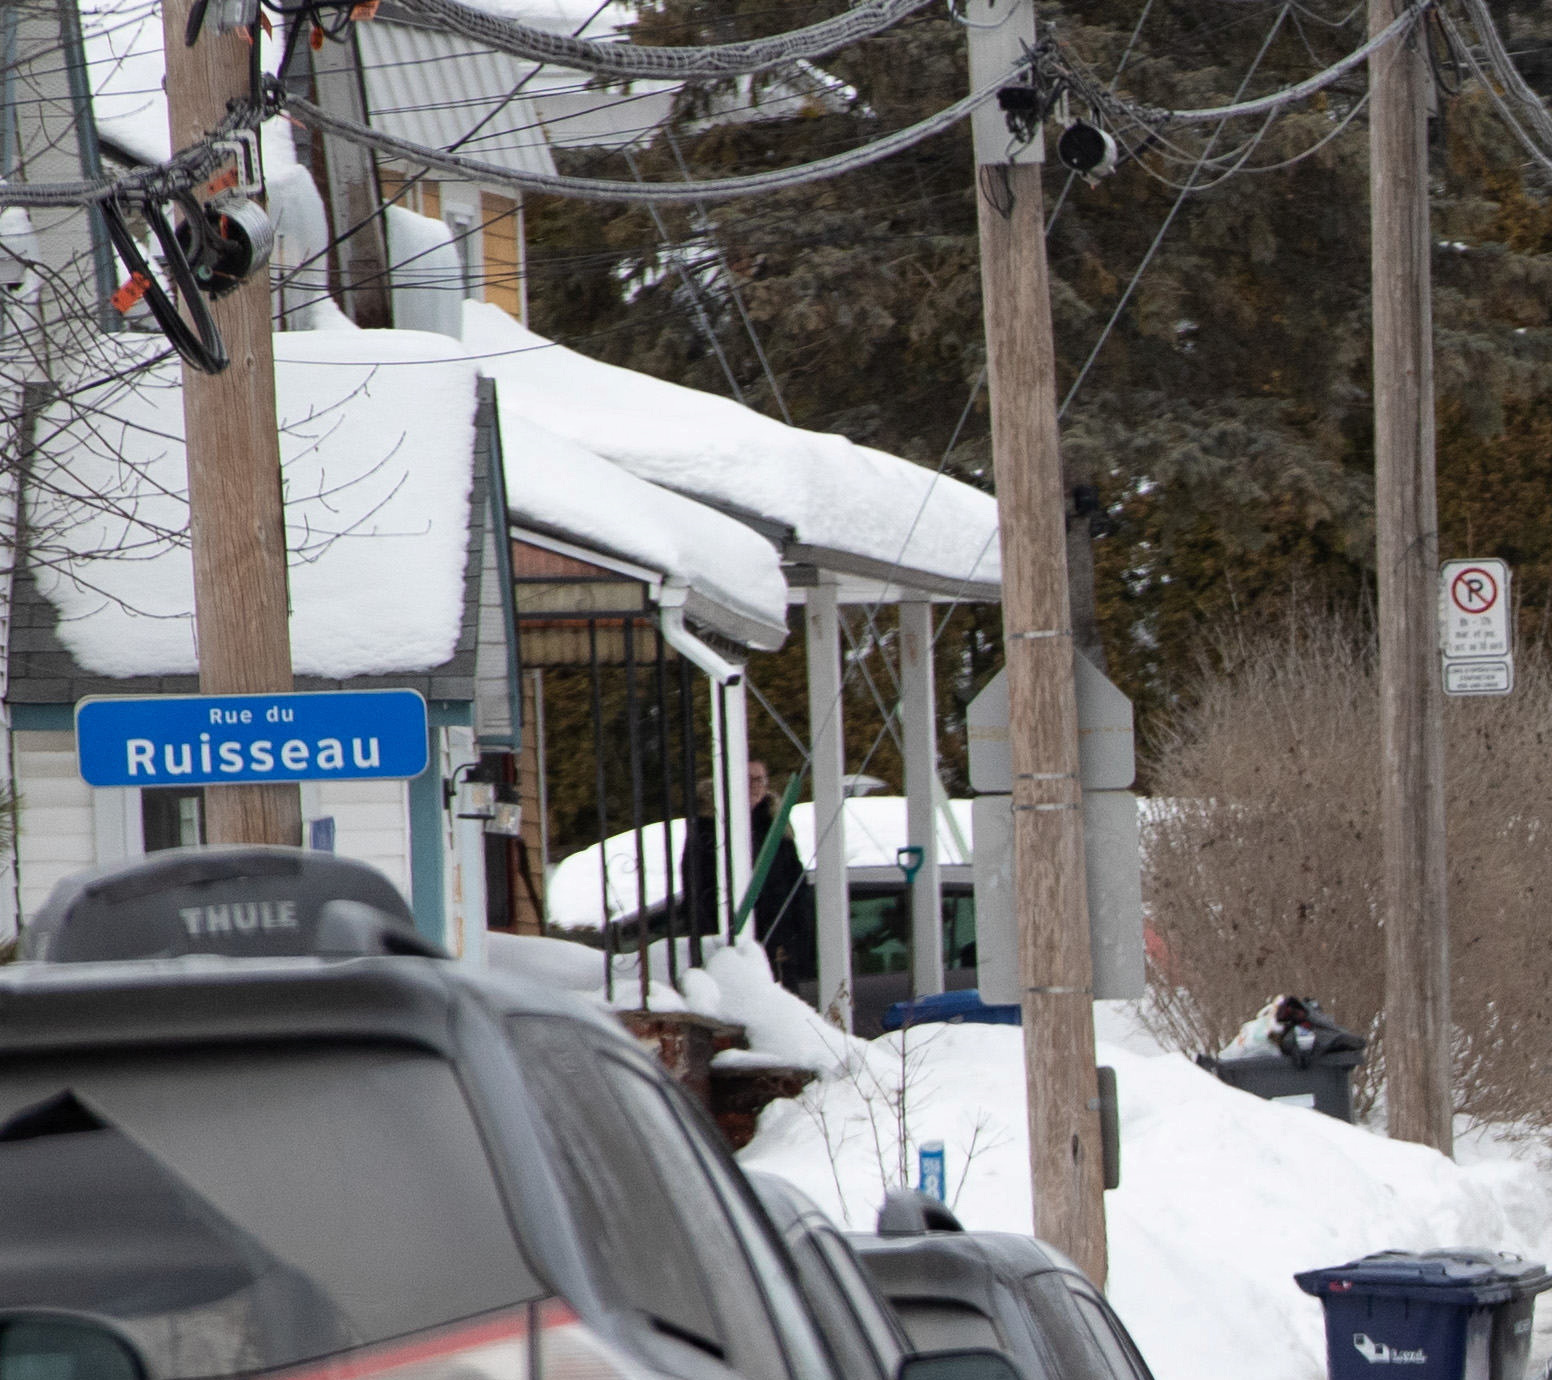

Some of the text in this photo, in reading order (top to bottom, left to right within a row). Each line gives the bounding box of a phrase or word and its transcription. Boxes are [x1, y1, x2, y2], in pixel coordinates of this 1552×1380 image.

[209, 705, 295, 725] Rue du
[125, 732, 381, 777] Ruisseau
[179, 900, 299, 936] THULE
